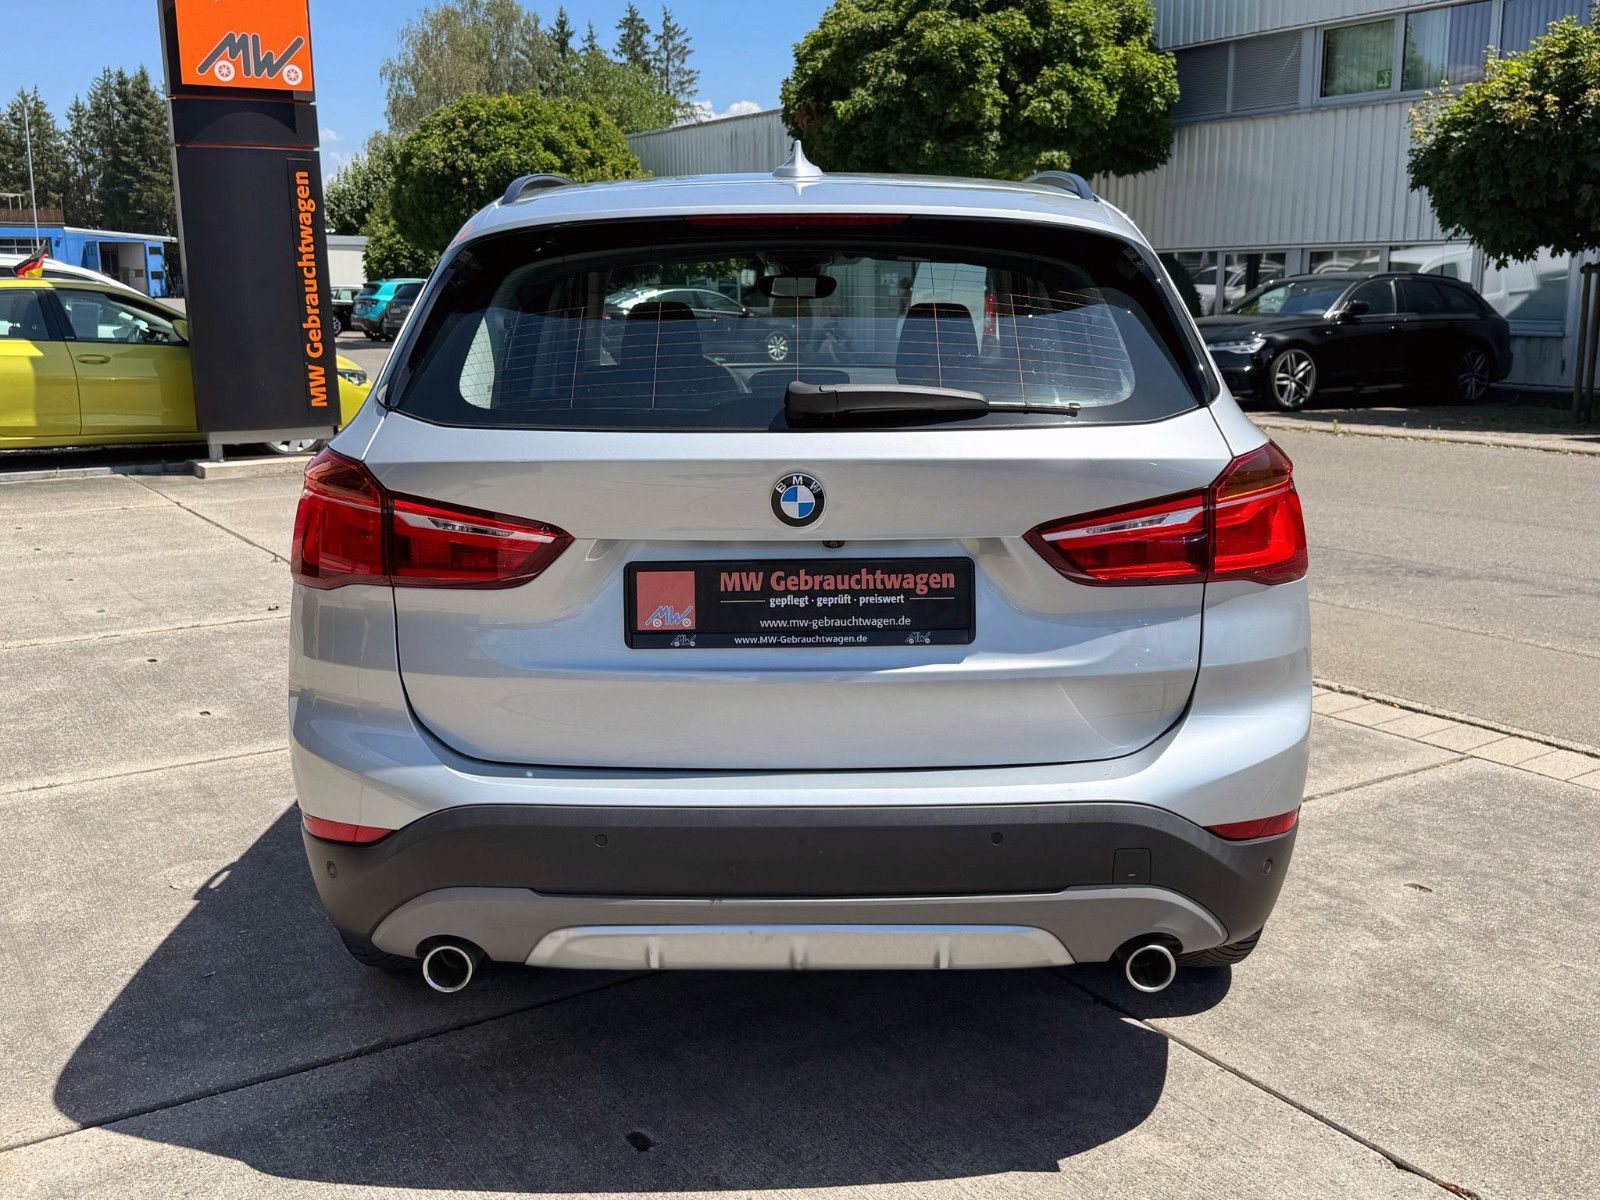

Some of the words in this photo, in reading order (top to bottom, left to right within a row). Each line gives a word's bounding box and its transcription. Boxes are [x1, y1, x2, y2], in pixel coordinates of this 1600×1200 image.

[196, 31, 304, 80] MW
[295, 171, 324, 359] Gebrauchtwagen
[308, 364, 328, 407] MW
[776, 475, 821, 494] BMW
[720, 571, 764, 592] MW
[770, 568, 955, 595] Gebrauchtwagen
[769, 595, 809, 608] gepflegt
[816, 594, 851, 607] geprüft
[859, 593, 905, 606] preiswert
[644, 605, 694, 627] MW
[759, 615, 912, 630] www.mw-gebrauchtwagen.de
[734, 634, 868, 646] www.MW-Gebrauchtwagen.de
